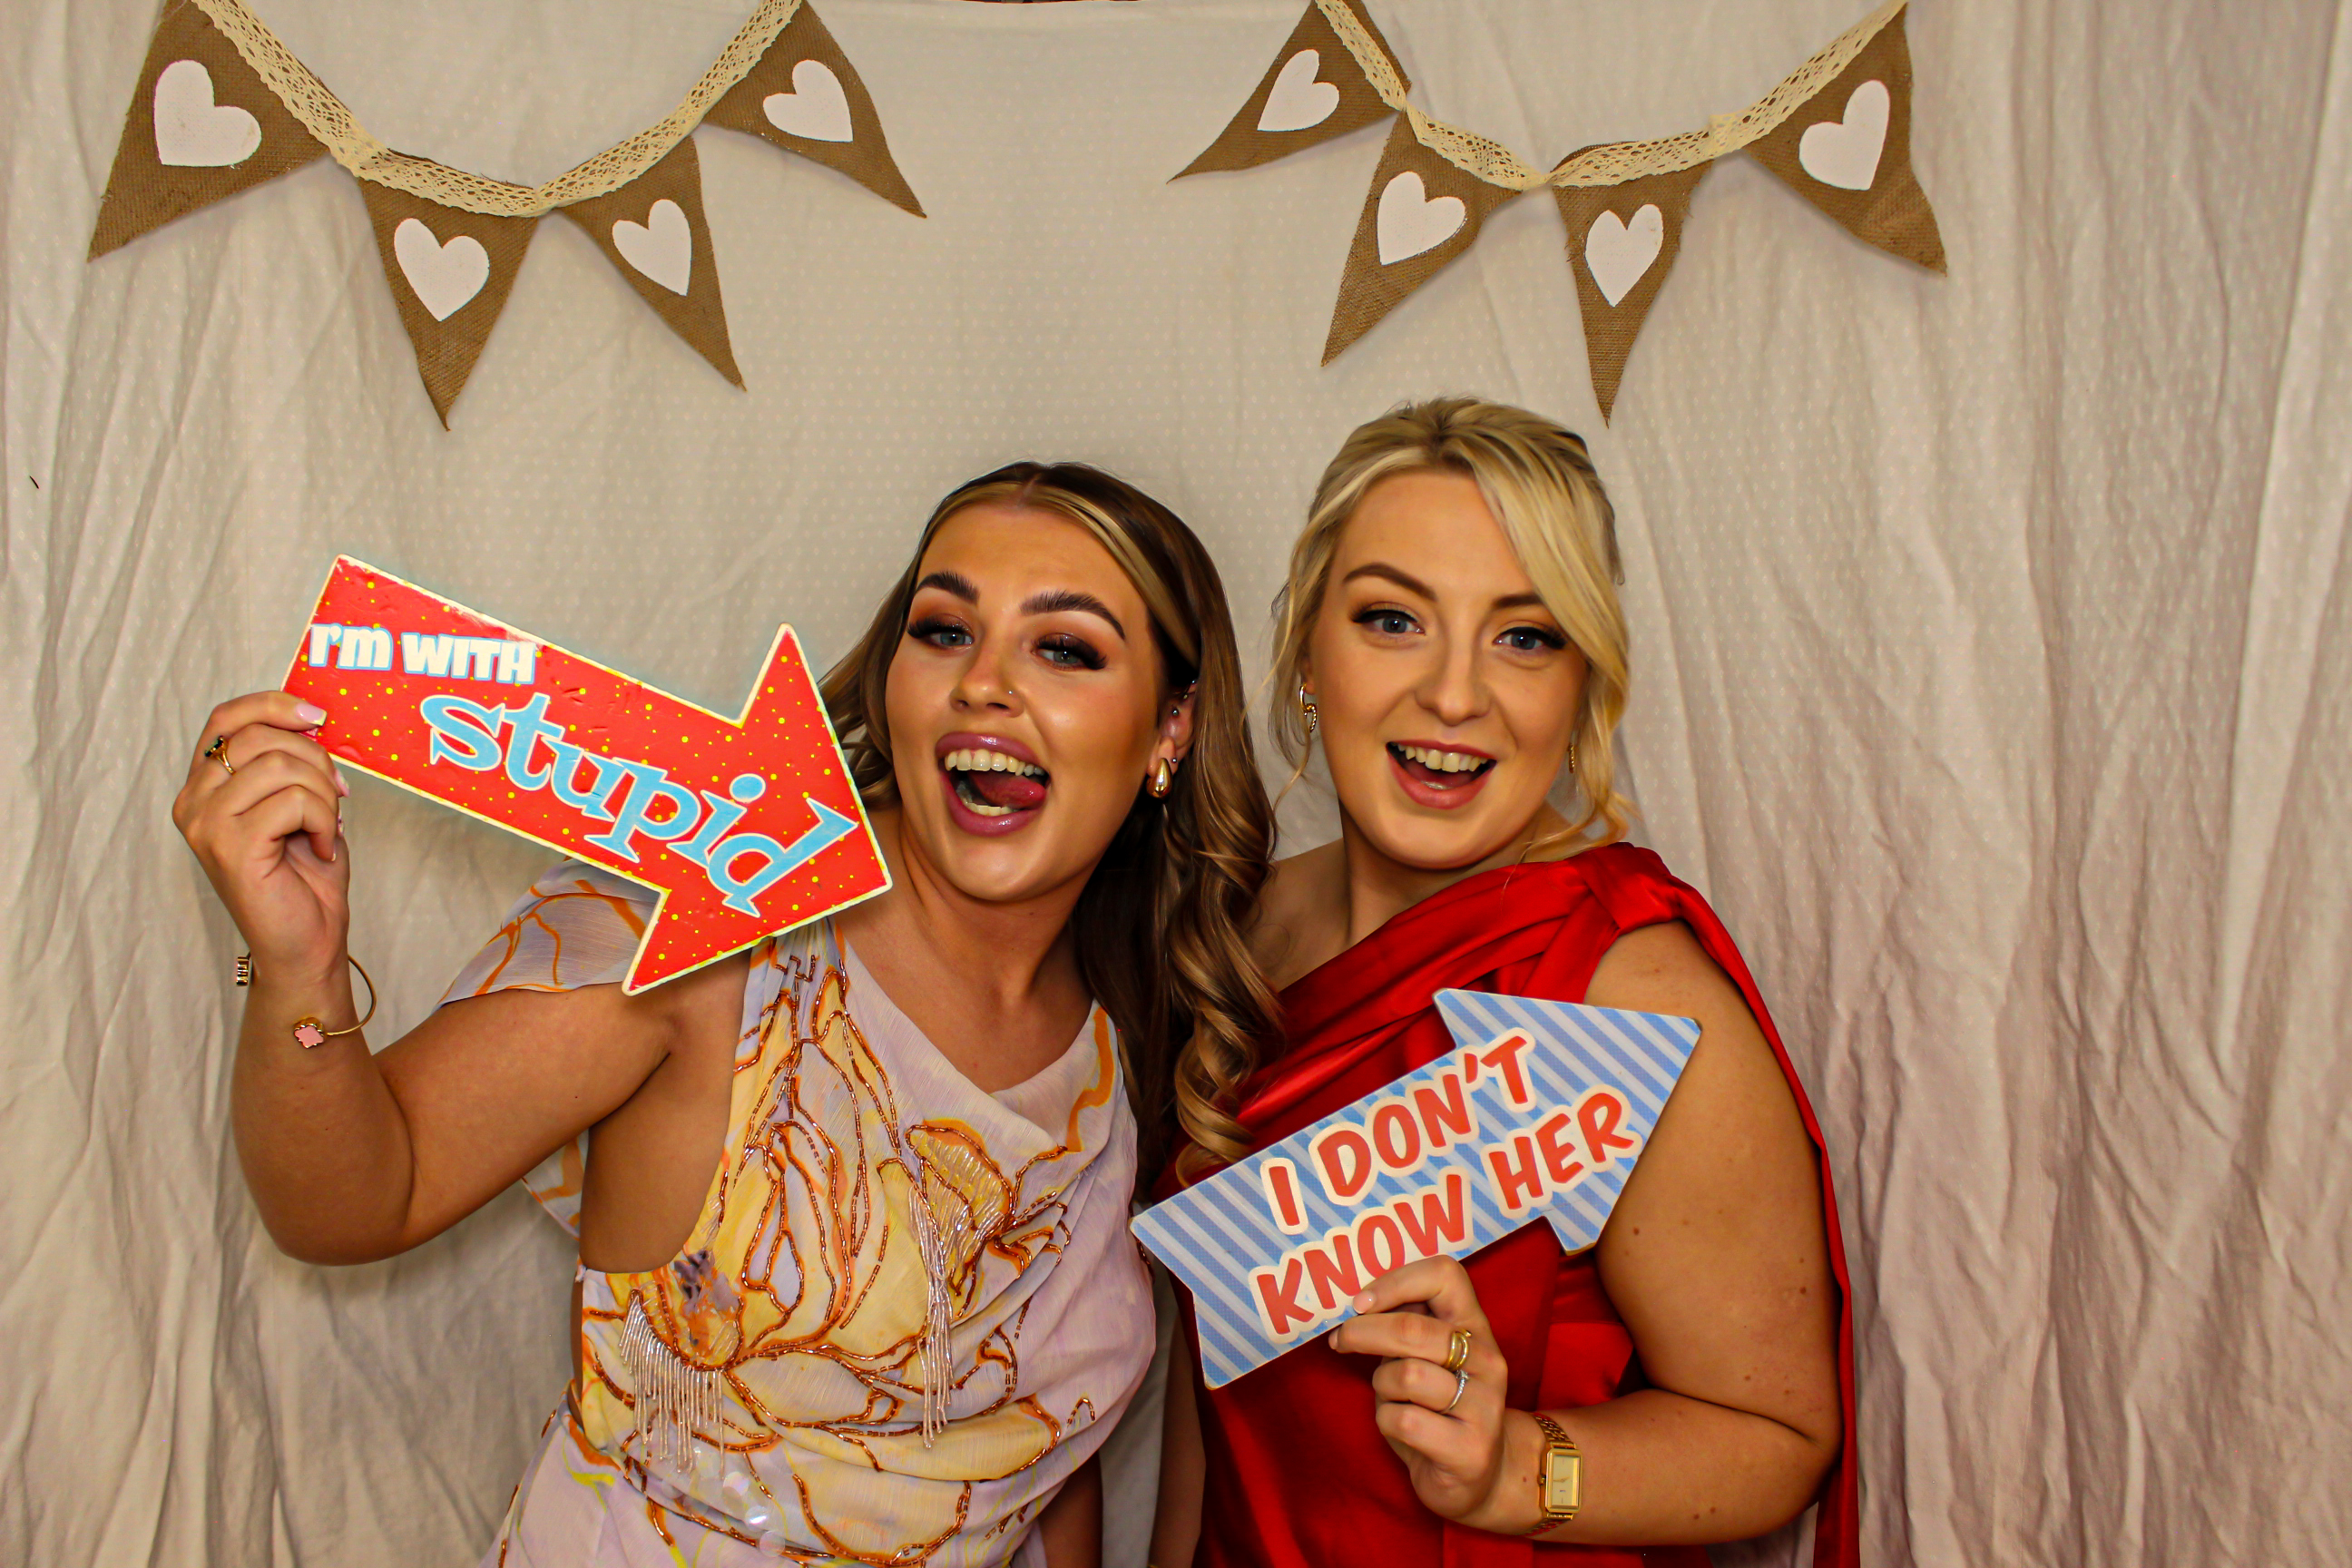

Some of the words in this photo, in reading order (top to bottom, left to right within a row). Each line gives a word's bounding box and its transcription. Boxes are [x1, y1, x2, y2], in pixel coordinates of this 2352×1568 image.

[400, 632, 537, 685] WITH
[420, 692, 858, 918] stupid
[1255, 1172, 1466, 1336] KNOW
[1488, 1091, 1637, 1212] HER
[1267, 1163, 1302, 1229] I
[1316, 1034, 1530, 1199] DON'T
